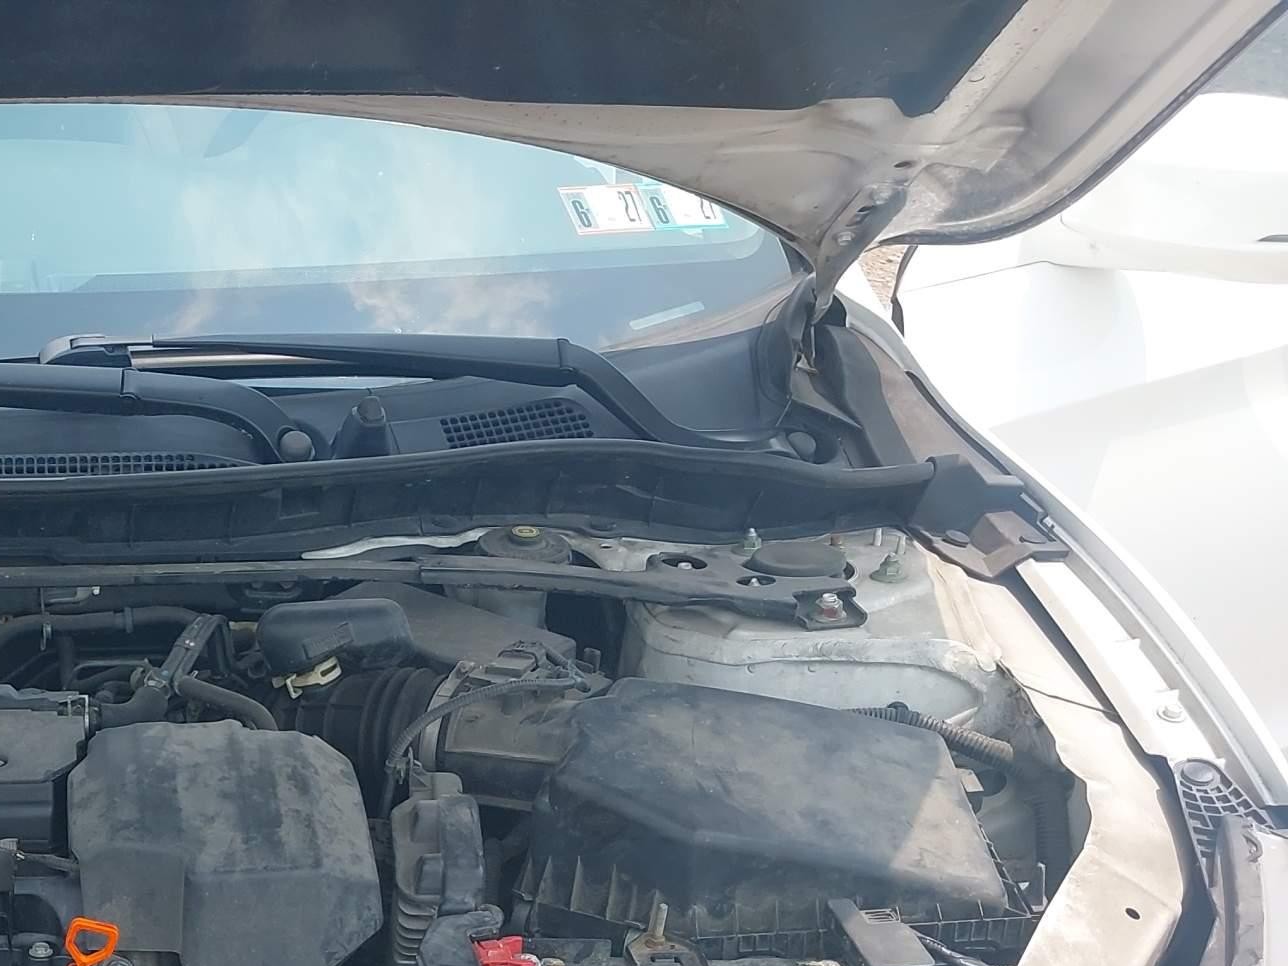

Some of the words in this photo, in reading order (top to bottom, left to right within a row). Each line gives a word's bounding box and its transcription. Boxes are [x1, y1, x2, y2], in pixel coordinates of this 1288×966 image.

[571, 199, 592, 228] 6
[617, 190, 643, 222] 27
[649, 196, 670, 225] 6
